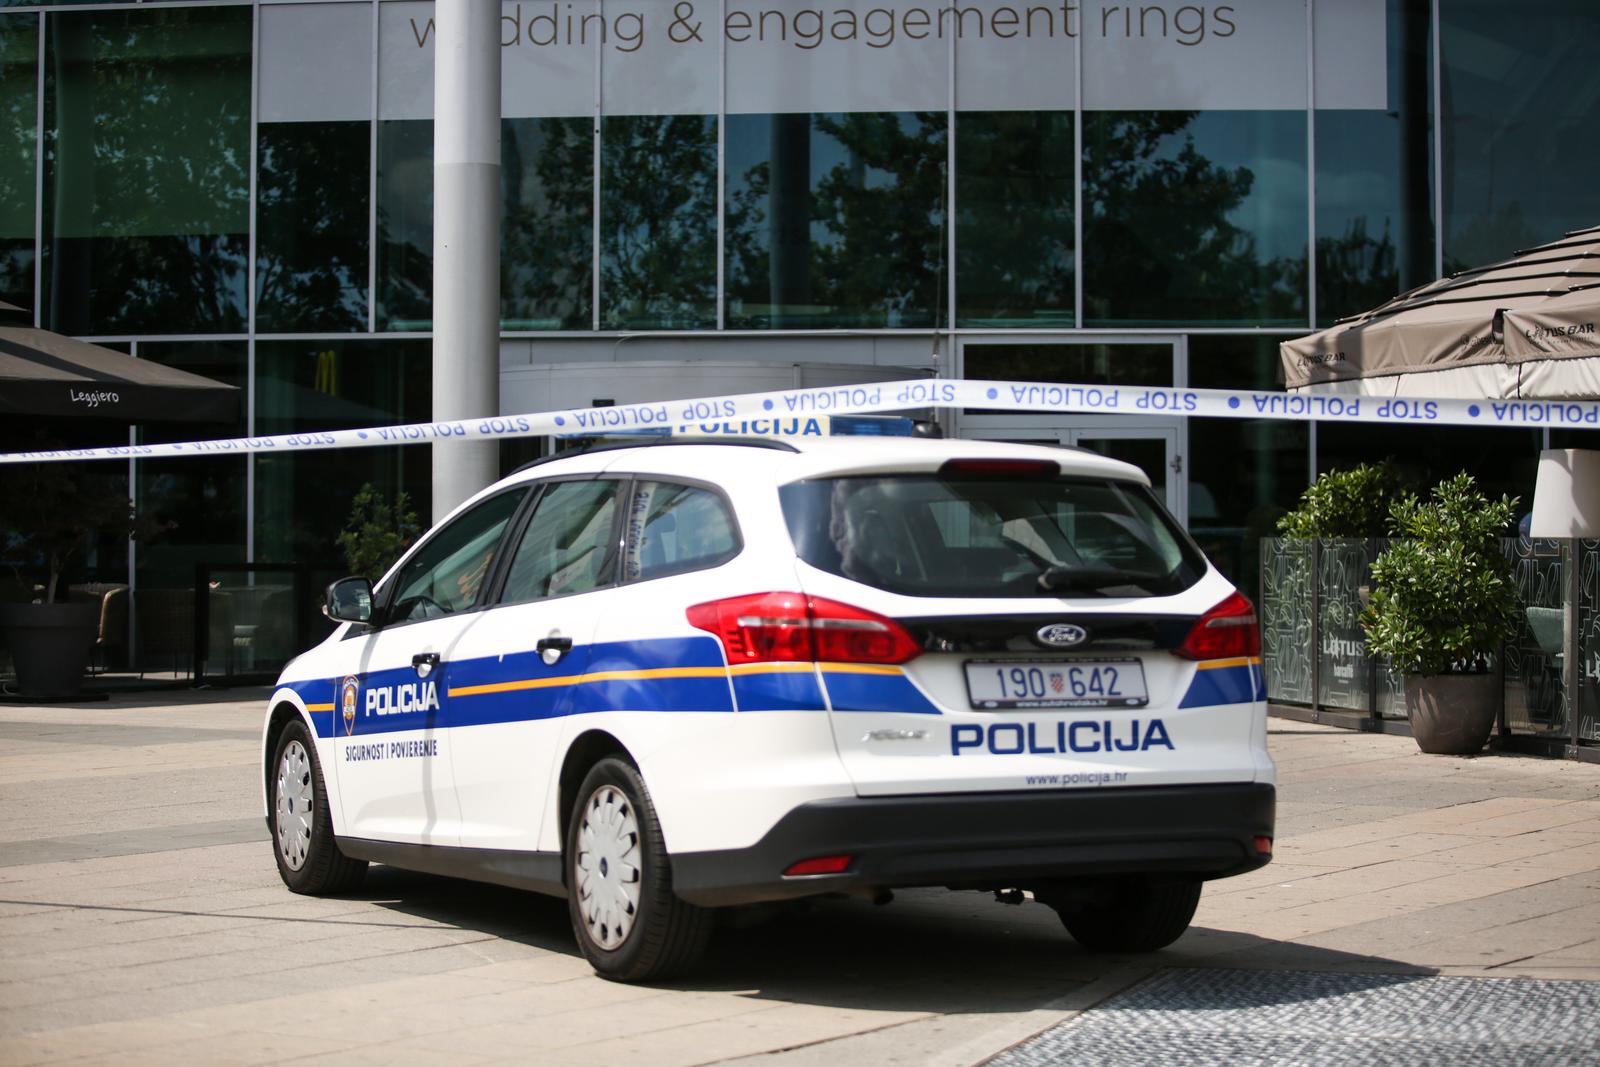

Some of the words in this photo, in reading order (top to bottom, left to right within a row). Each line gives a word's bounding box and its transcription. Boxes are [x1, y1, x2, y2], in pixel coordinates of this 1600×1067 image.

[410, 3, 644, 52] wdding
[668, 1, 703, 43] &
[725, 0, 1079, 49] engagement
[1103, 4, 1237, 46] rings
[1567, 322, 1595, 336] BAR
[70, 389, 119, 407] Leggiero
[784, 387, 881, 412] POLICIJA
[897, 384, 955, 402] STOP
[1010, 385, 1120, 408] POLICIJA
[1136, 391, 1198, 411] STOP
[573, 405, 668, 428] POLICIJA
[683, 400, 737, 420] STOP
[1251, 394, 1361, 418] POLICIJA
[1376, 399, 1438, 420] STOP
[1491, 401, 1599, 424] POLICIJA
[376, 423, 466, 441] POLICIJA
[479, 416, 531, 435] STOP
[679, 418, 822, 436] OLICIJA
[997, 667, 1046, 698] 190
[1068, 666, 1122, 698] 642
[366, 681, 440, 717] POLICIJA
[951, 718, 1176, 756] POLICIJA
[345, 743, 385, 762] SIGURNOST
[391, 740, 438, 759] POVJERENJE
[1025, 770, 1128, 788] www.policija.hr
